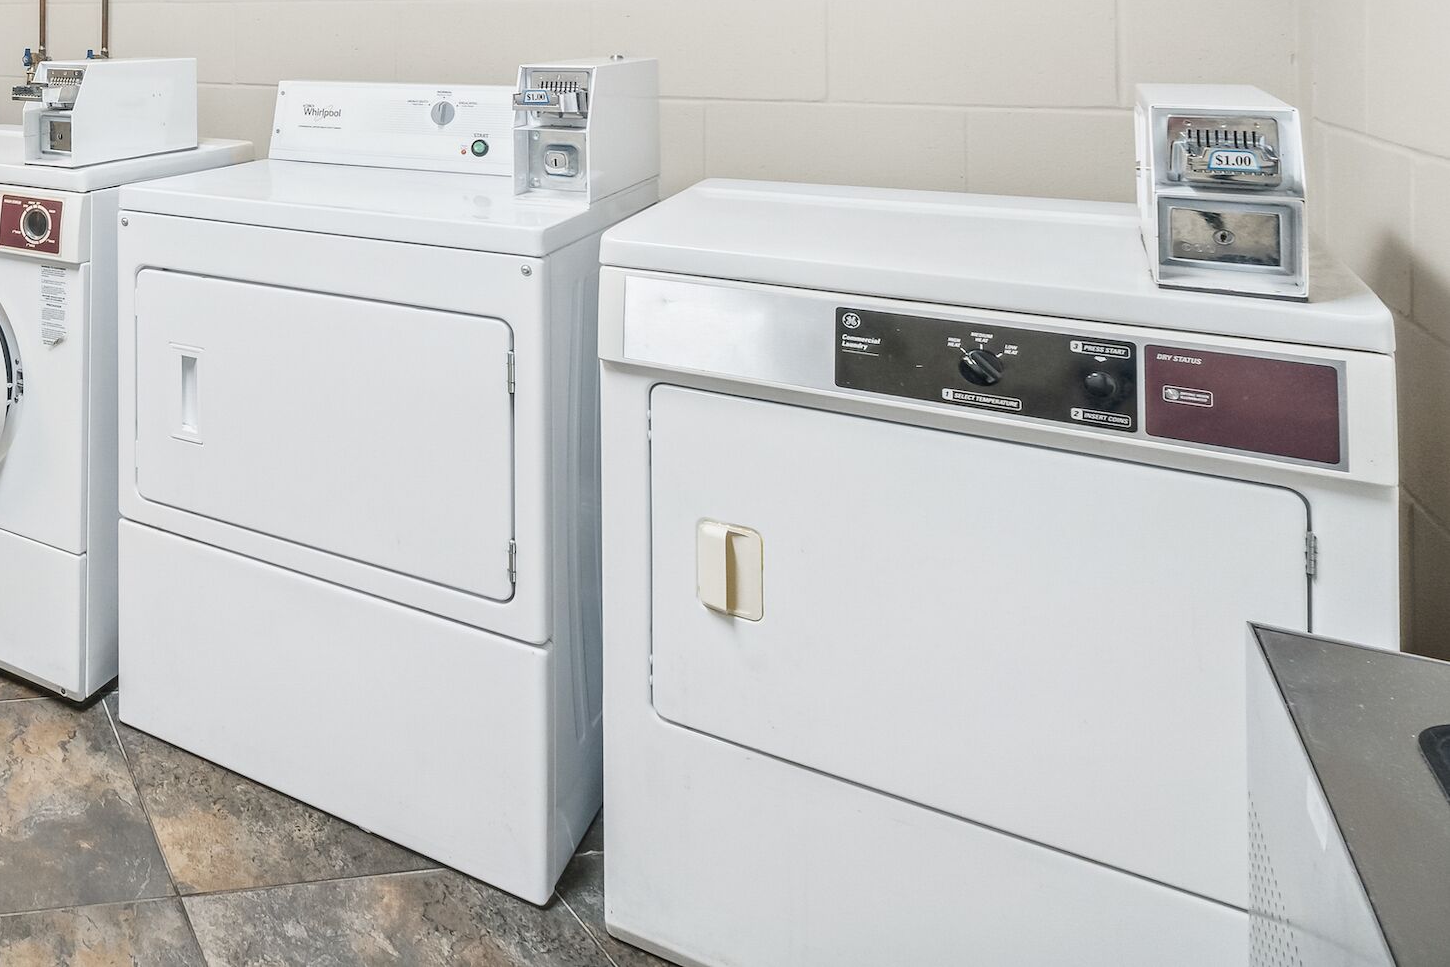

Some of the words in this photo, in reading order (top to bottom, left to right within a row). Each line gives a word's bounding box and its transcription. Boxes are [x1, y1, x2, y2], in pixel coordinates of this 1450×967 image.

[526, 93, 546, 101] $1.00
[303, 107, 342, 119] Whirlpool
[1215, 154, 1252, 167] $1.00
[841, 333, 882, 345] Commercial
[841, 340, 869, 351] Laundry
[1083, 345, 1105, 354] PRESS
[1105, 347, 1127, 355] START
[1003, 348, 1019, 356] HEAT
[1156, 353, 1172, 361] DRY
[1172, 355, 1203, 365] STATUS
[953, 392, 975, 402] SELECT
[975, 395, 1019, 408] TEMPERATURE
[1083, 413, 1108, 421] INSERT
[1107, 416, 1129, 425] COINS
